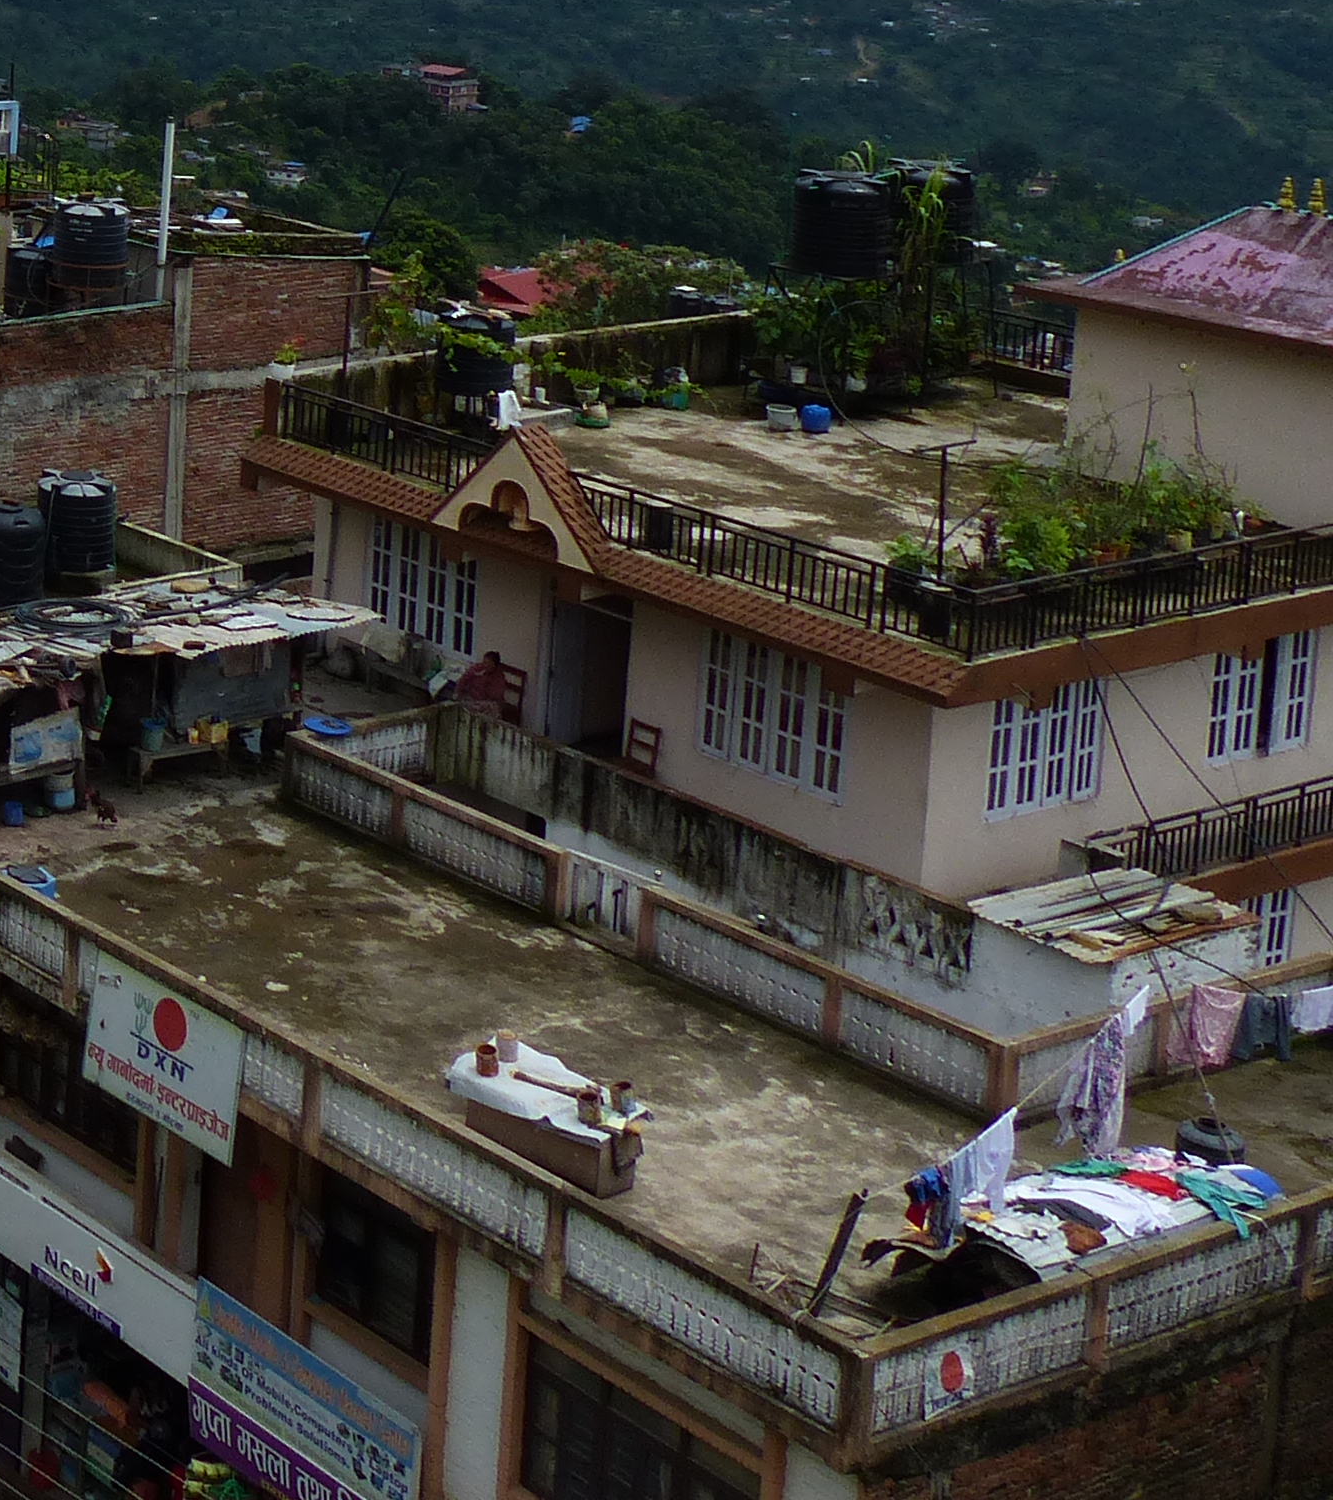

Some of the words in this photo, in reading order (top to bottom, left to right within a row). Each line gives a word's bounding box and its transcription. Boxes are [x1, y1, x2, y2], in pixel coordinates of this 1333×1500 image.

[136, 1041, 185, 1082] DXN
[44, 1245, 98, 1296] Ncell
[191, 1391, 232, 1448] गुप्ता
[195, 1335, 209, 1351] All
[369, 1457, 409, 1494] Laptop
[244, 1384, 294, 1427] Problems
